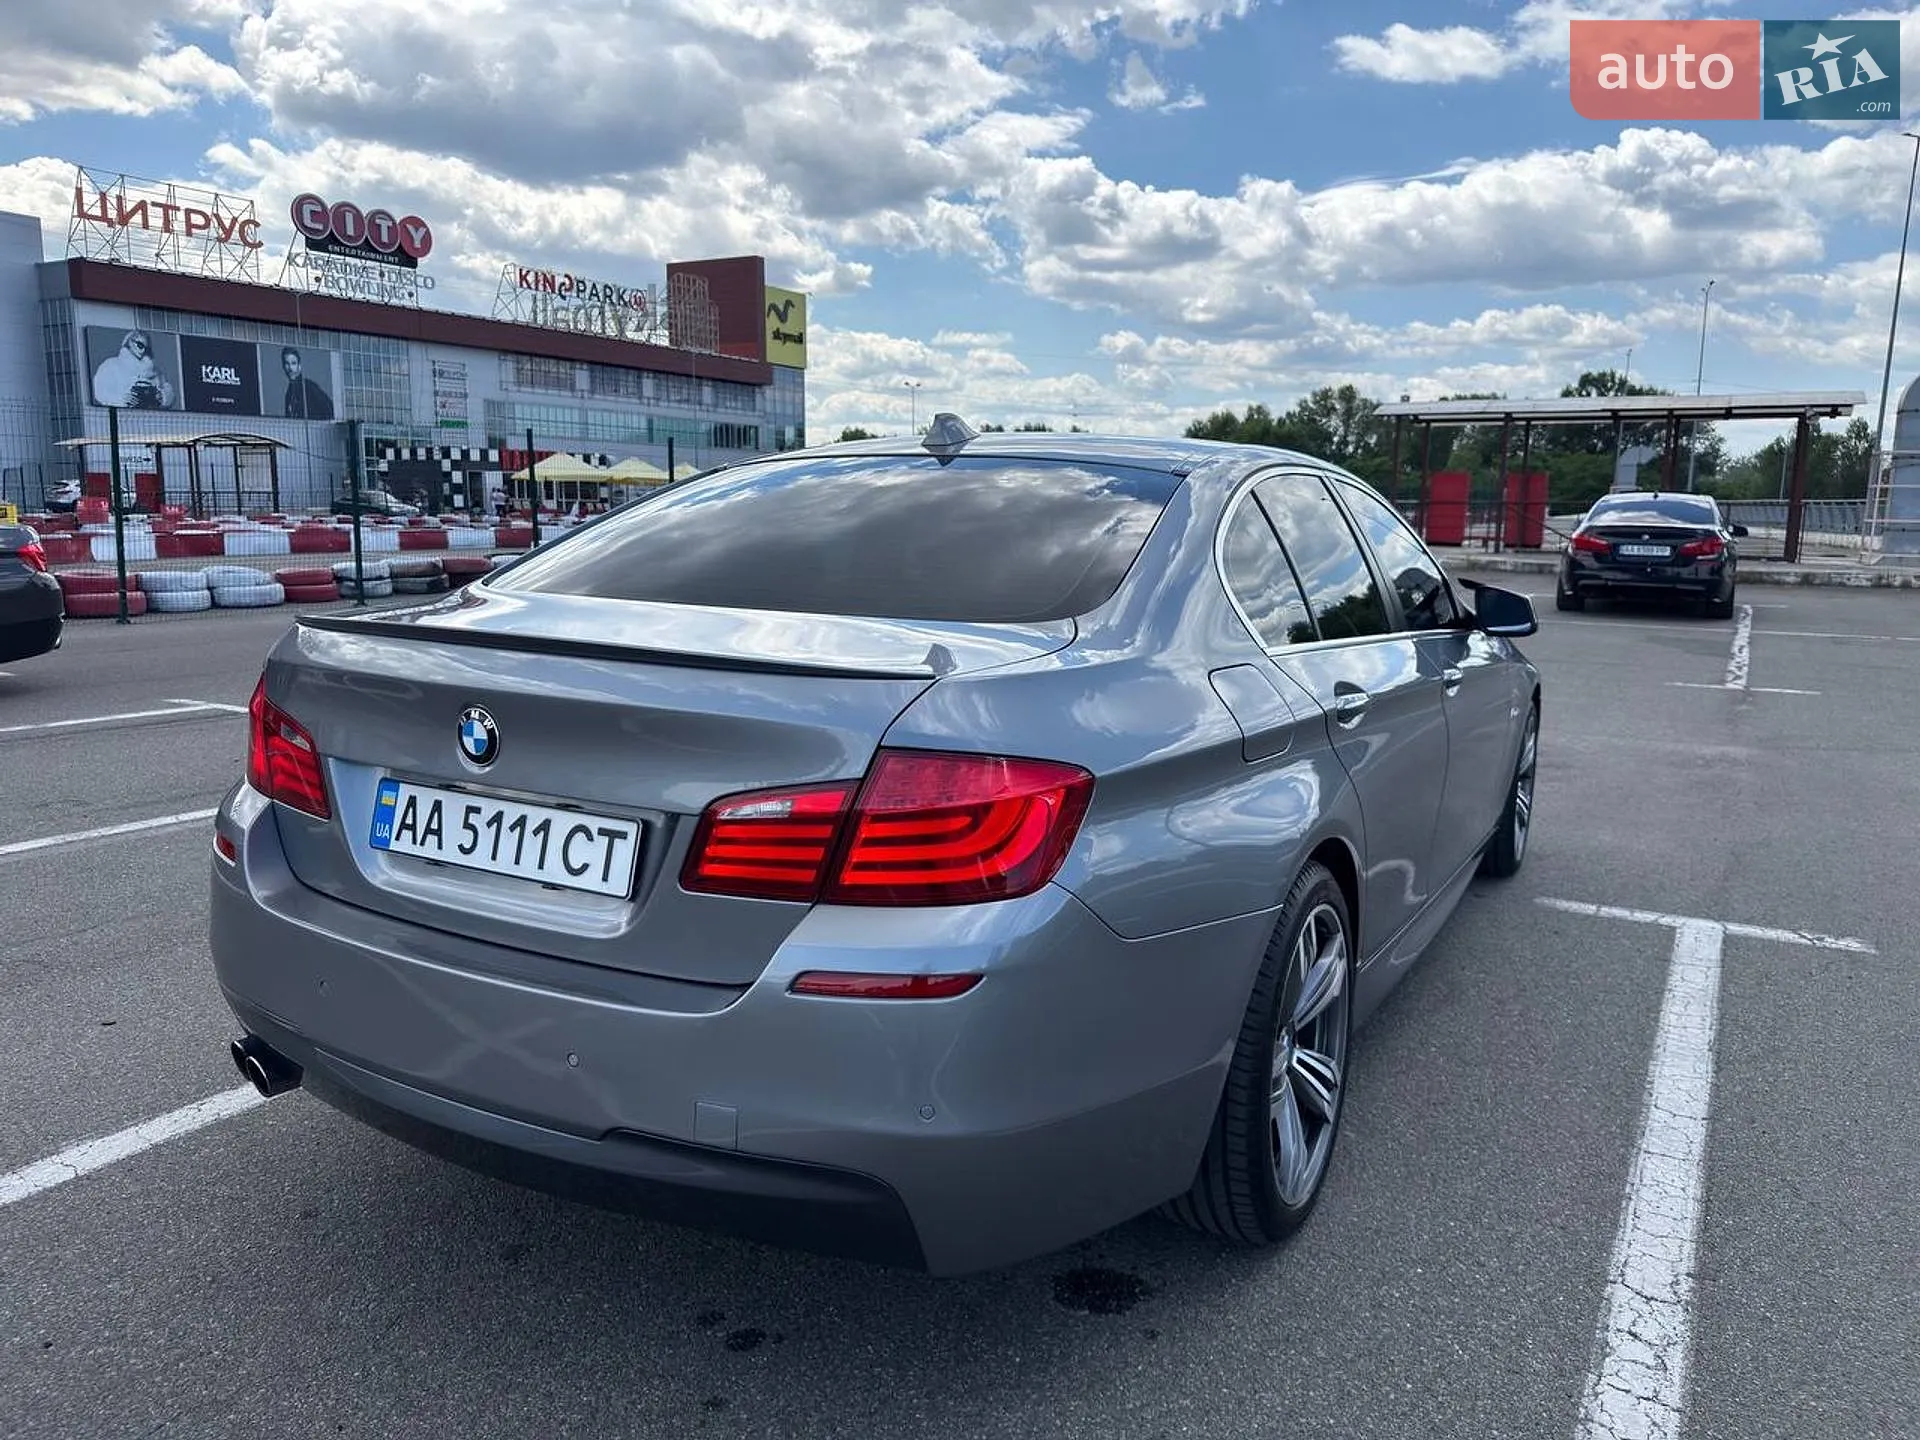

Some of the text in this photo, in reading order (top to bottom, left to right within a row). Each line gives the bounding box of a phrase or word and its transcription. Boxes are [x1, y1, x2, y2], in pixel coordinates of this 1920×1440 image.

[75, 186, 264, 249] ЦИТРУС
[299, 203, 431, 249] CITY
[202, 364, 240, 380] KARL
[375, 821, 391, 841] UA
[394, 794, 629, 883] AA 5111 CT
